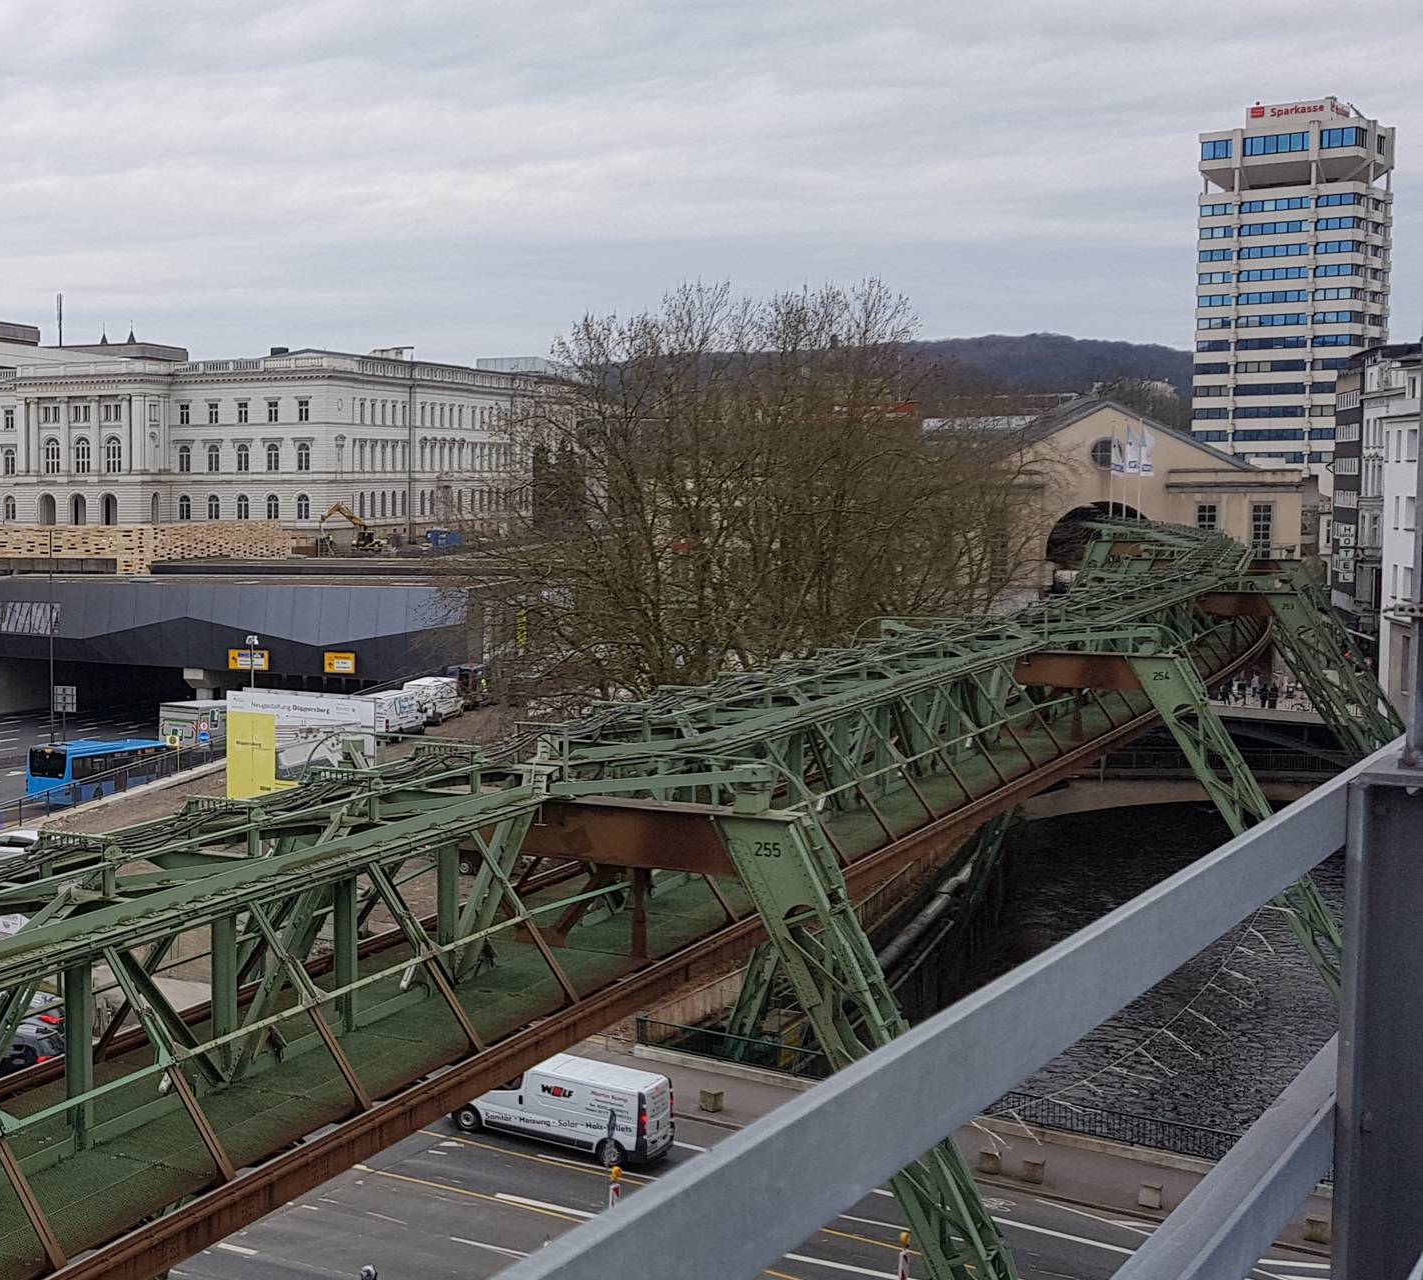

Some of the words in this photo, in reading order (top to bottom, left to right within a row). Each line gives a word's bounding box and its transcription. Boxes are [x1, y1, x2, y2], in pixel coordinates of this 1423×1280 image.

[1269, 104, 1325, 118] Sparkasse
[1343, 526, 1352, 581] HOTEL
[1153, 671, 1170, 681] 254
[754, 841, 782, 858] 255
